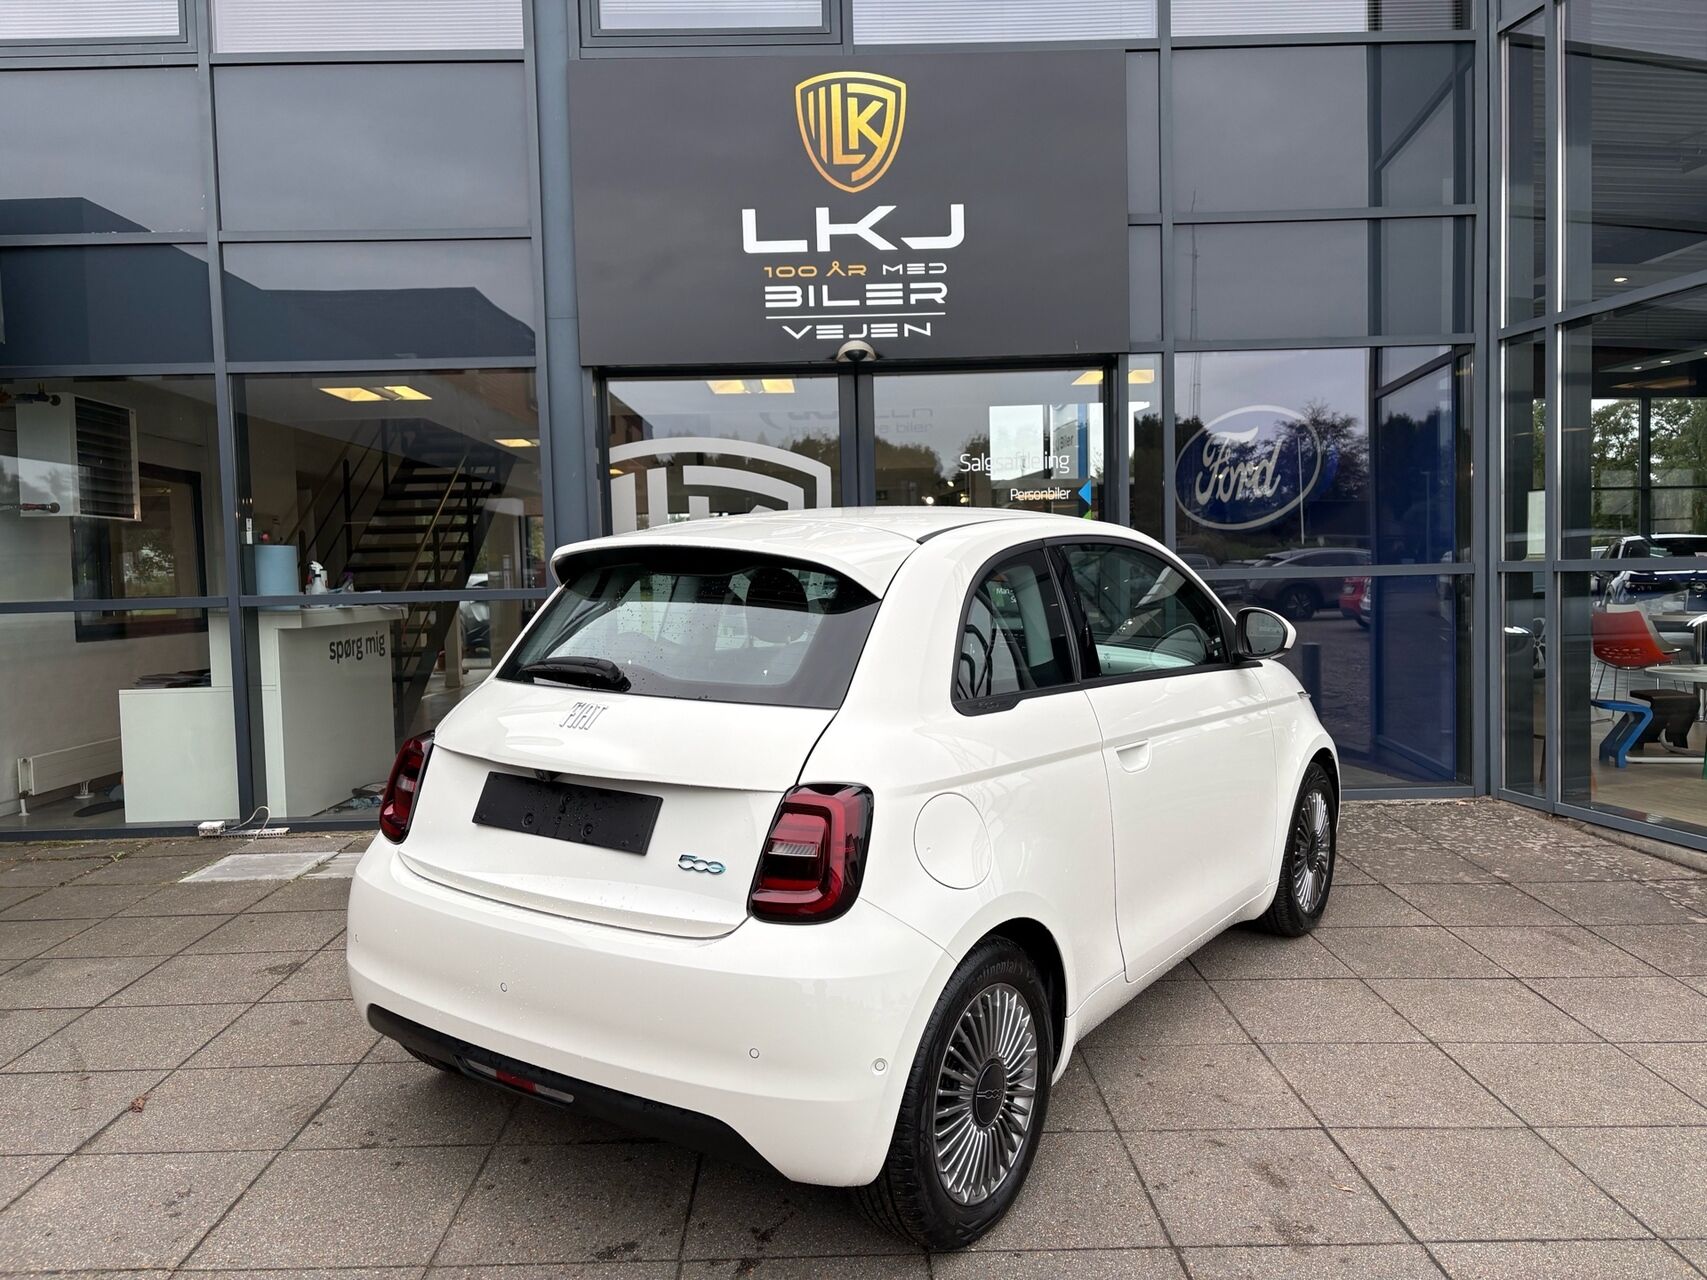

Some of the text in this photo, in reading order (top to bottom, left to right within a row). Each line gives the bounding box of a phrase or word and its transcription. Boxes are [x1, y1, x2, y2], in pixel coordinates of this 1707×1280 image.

[742, 204, 965, 254] LKJ
[763, 260, 948, 278] 100 ÅR MED
[764, 282, 949, 308] BILER
[781, 321, 932, 340] VEJEN
[1195, 425, 1282, 506] Ford
[1010, 486, 1072, 501] Personbiler
[329, 630, 386, 664] spørg mig
[559, 701, 609, 731] FIAT
